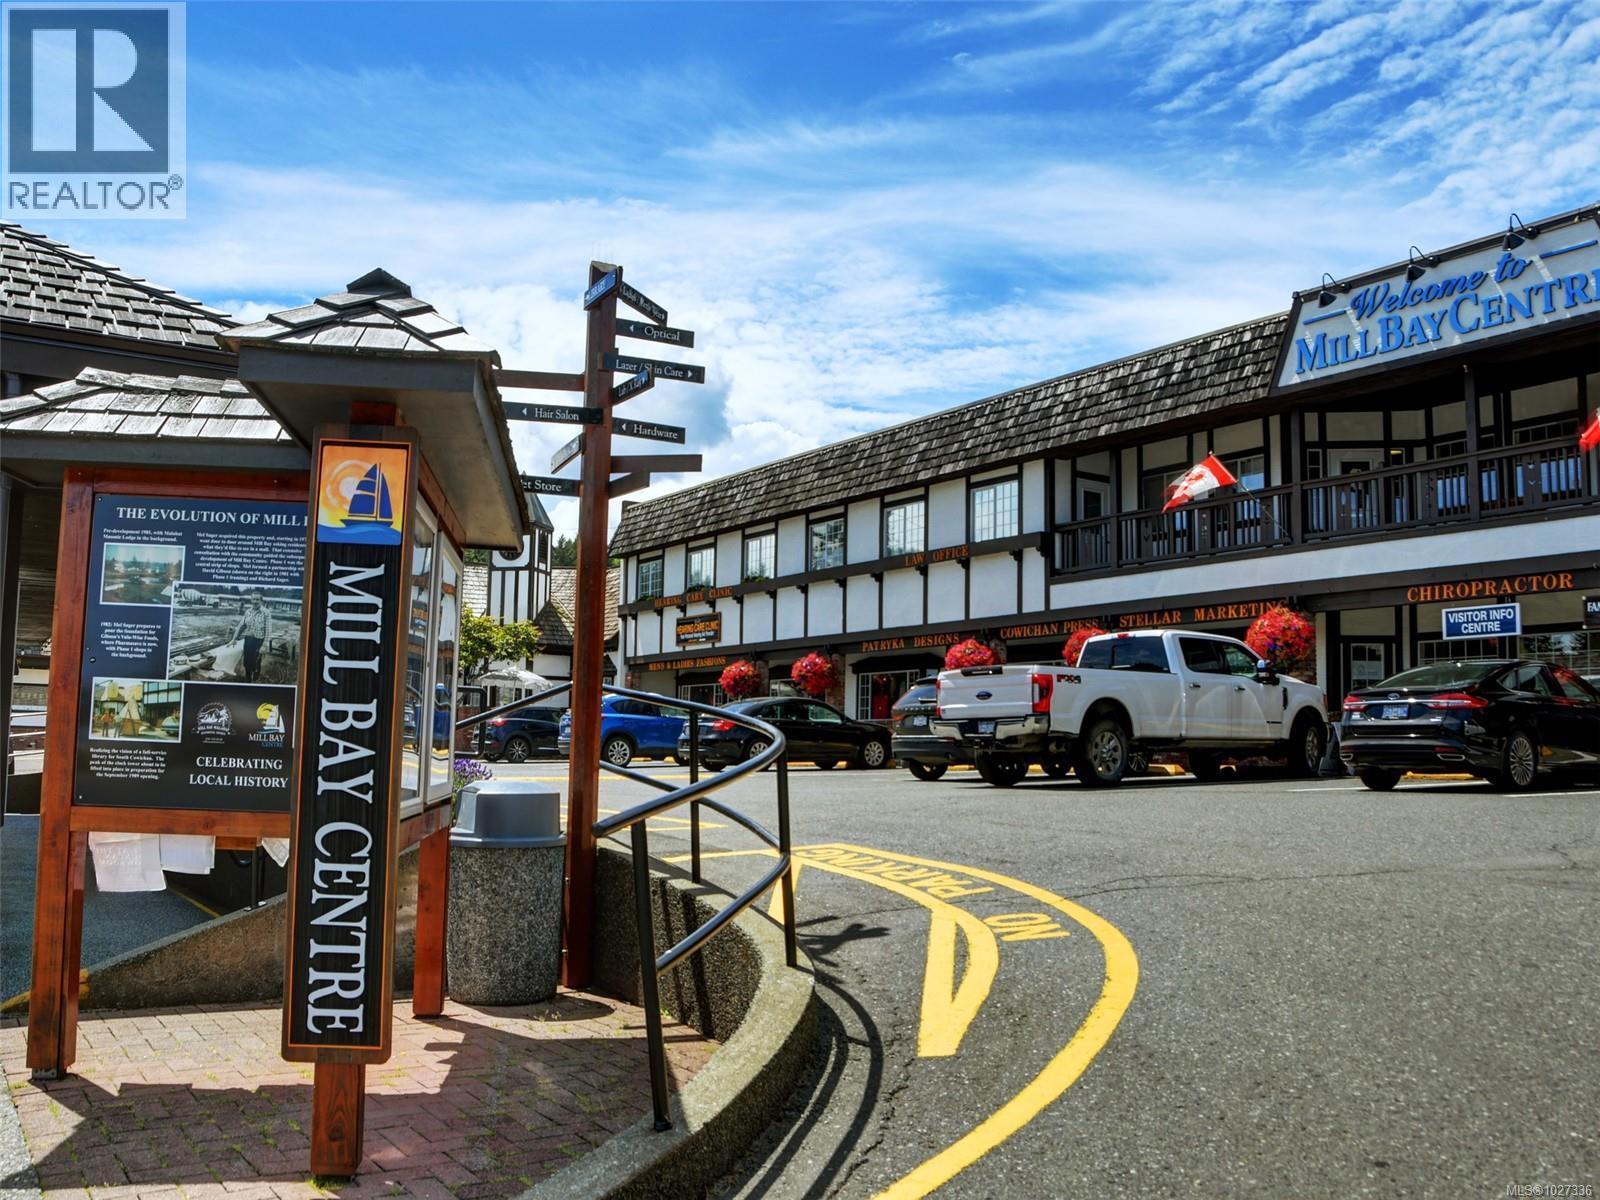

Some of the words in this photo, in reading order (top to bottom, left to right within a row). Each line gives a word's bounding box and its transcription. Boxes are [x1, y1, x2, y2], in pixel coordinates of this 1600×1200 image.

[1352, 268, 1490, 320] Welcome
[1495, 253, 1533, 282] to
[644, 325, 680, 340] Optical
[1295, 329, 1378, 374] MILL
[1377, 309, 1448, 354] BAY
[616, 360, 636, 371] Lazer
[664, 366, 684, 377] Care
[534, 408, 553, 418] Hair
[556, 409, 579, 420] Salon
[634, 424, 678, 439] Hardware
[521, 480, 531, 489] et
[534, 480, 562, 492] Store
[117, 507, 146, 520] THE
[150, 509, 237, 523] EVOLUTION
[240, 513, 260, 524] OF
[263, 514, 300, 526] MILL
[904, 555, 926, 567] LAW
[933, 545, 969, 562] OFFICE
[1407, 572, 1574, 602] CHIROPRACTOR
[321, 561, 385, 685] MILL
[1119, 610, 1181, 628] STELLAR
[1448, 610, 1488, 623] VISITOR
[1489, 608, 1514, 620] INFO
[1000, 623, 1058, 639] COWICHAN
[1064, 618, 1099, 635] PRESS
[1461, 621, 1501, 634] CENTRE
[862, 639, 904, 652] PATRYKA
[914, 632, 960, 647] DESIGNS
[249, 733, 267, 742] MILL
[269, 734, 285, 742] BAY
[317, 698, 377, 804] BAY
[196, 756, 282, 770] CELEBRATING
[189, 774, 231, 786] LOCAL
[234, 776, 288, 788] HISTORY
[796, 848, 995, 899] PARKING
[306, 822, 373, 1034] CENTRE
[983, 912, 1071, 942] NO
